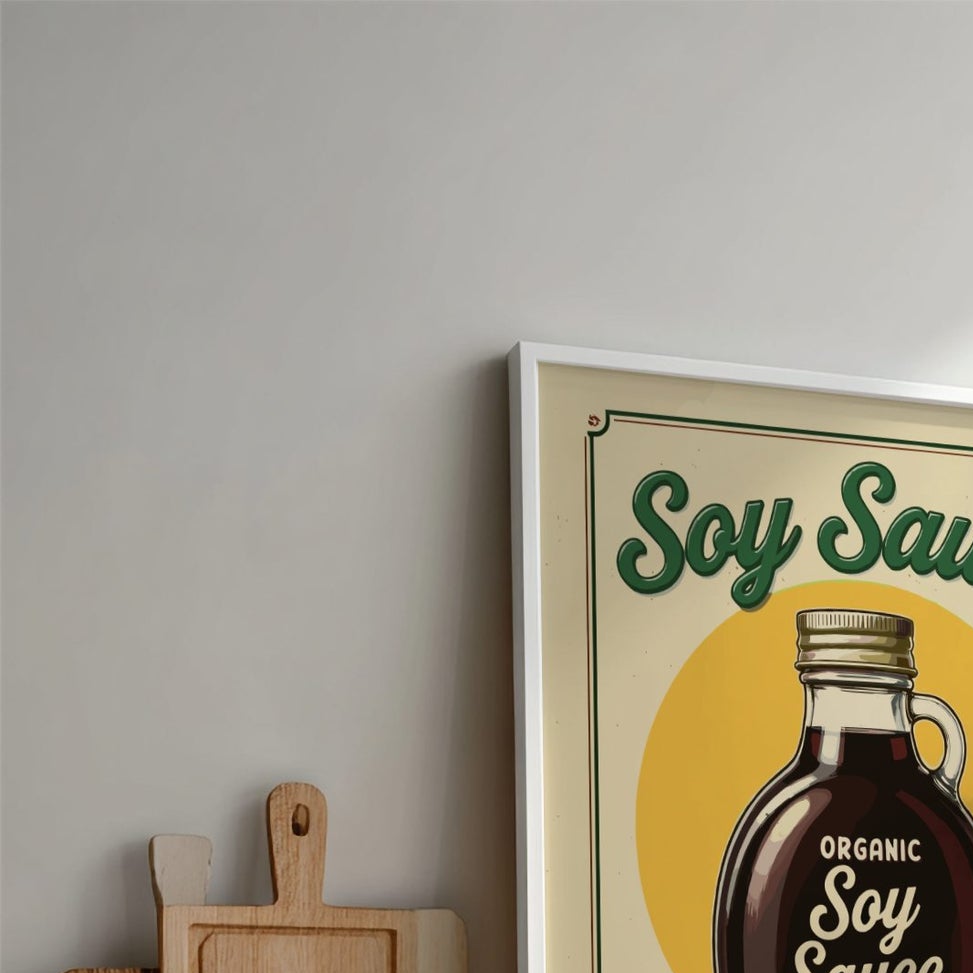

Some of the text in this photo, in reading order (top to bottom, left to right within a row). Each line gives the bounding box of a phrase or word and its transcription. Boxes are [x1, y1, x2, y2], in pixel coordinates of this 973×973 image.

[617, 470, 802, 610] Soy
[820, 835, 921, 862] ORGANIC
[809, 864, 921, 955] Soy
